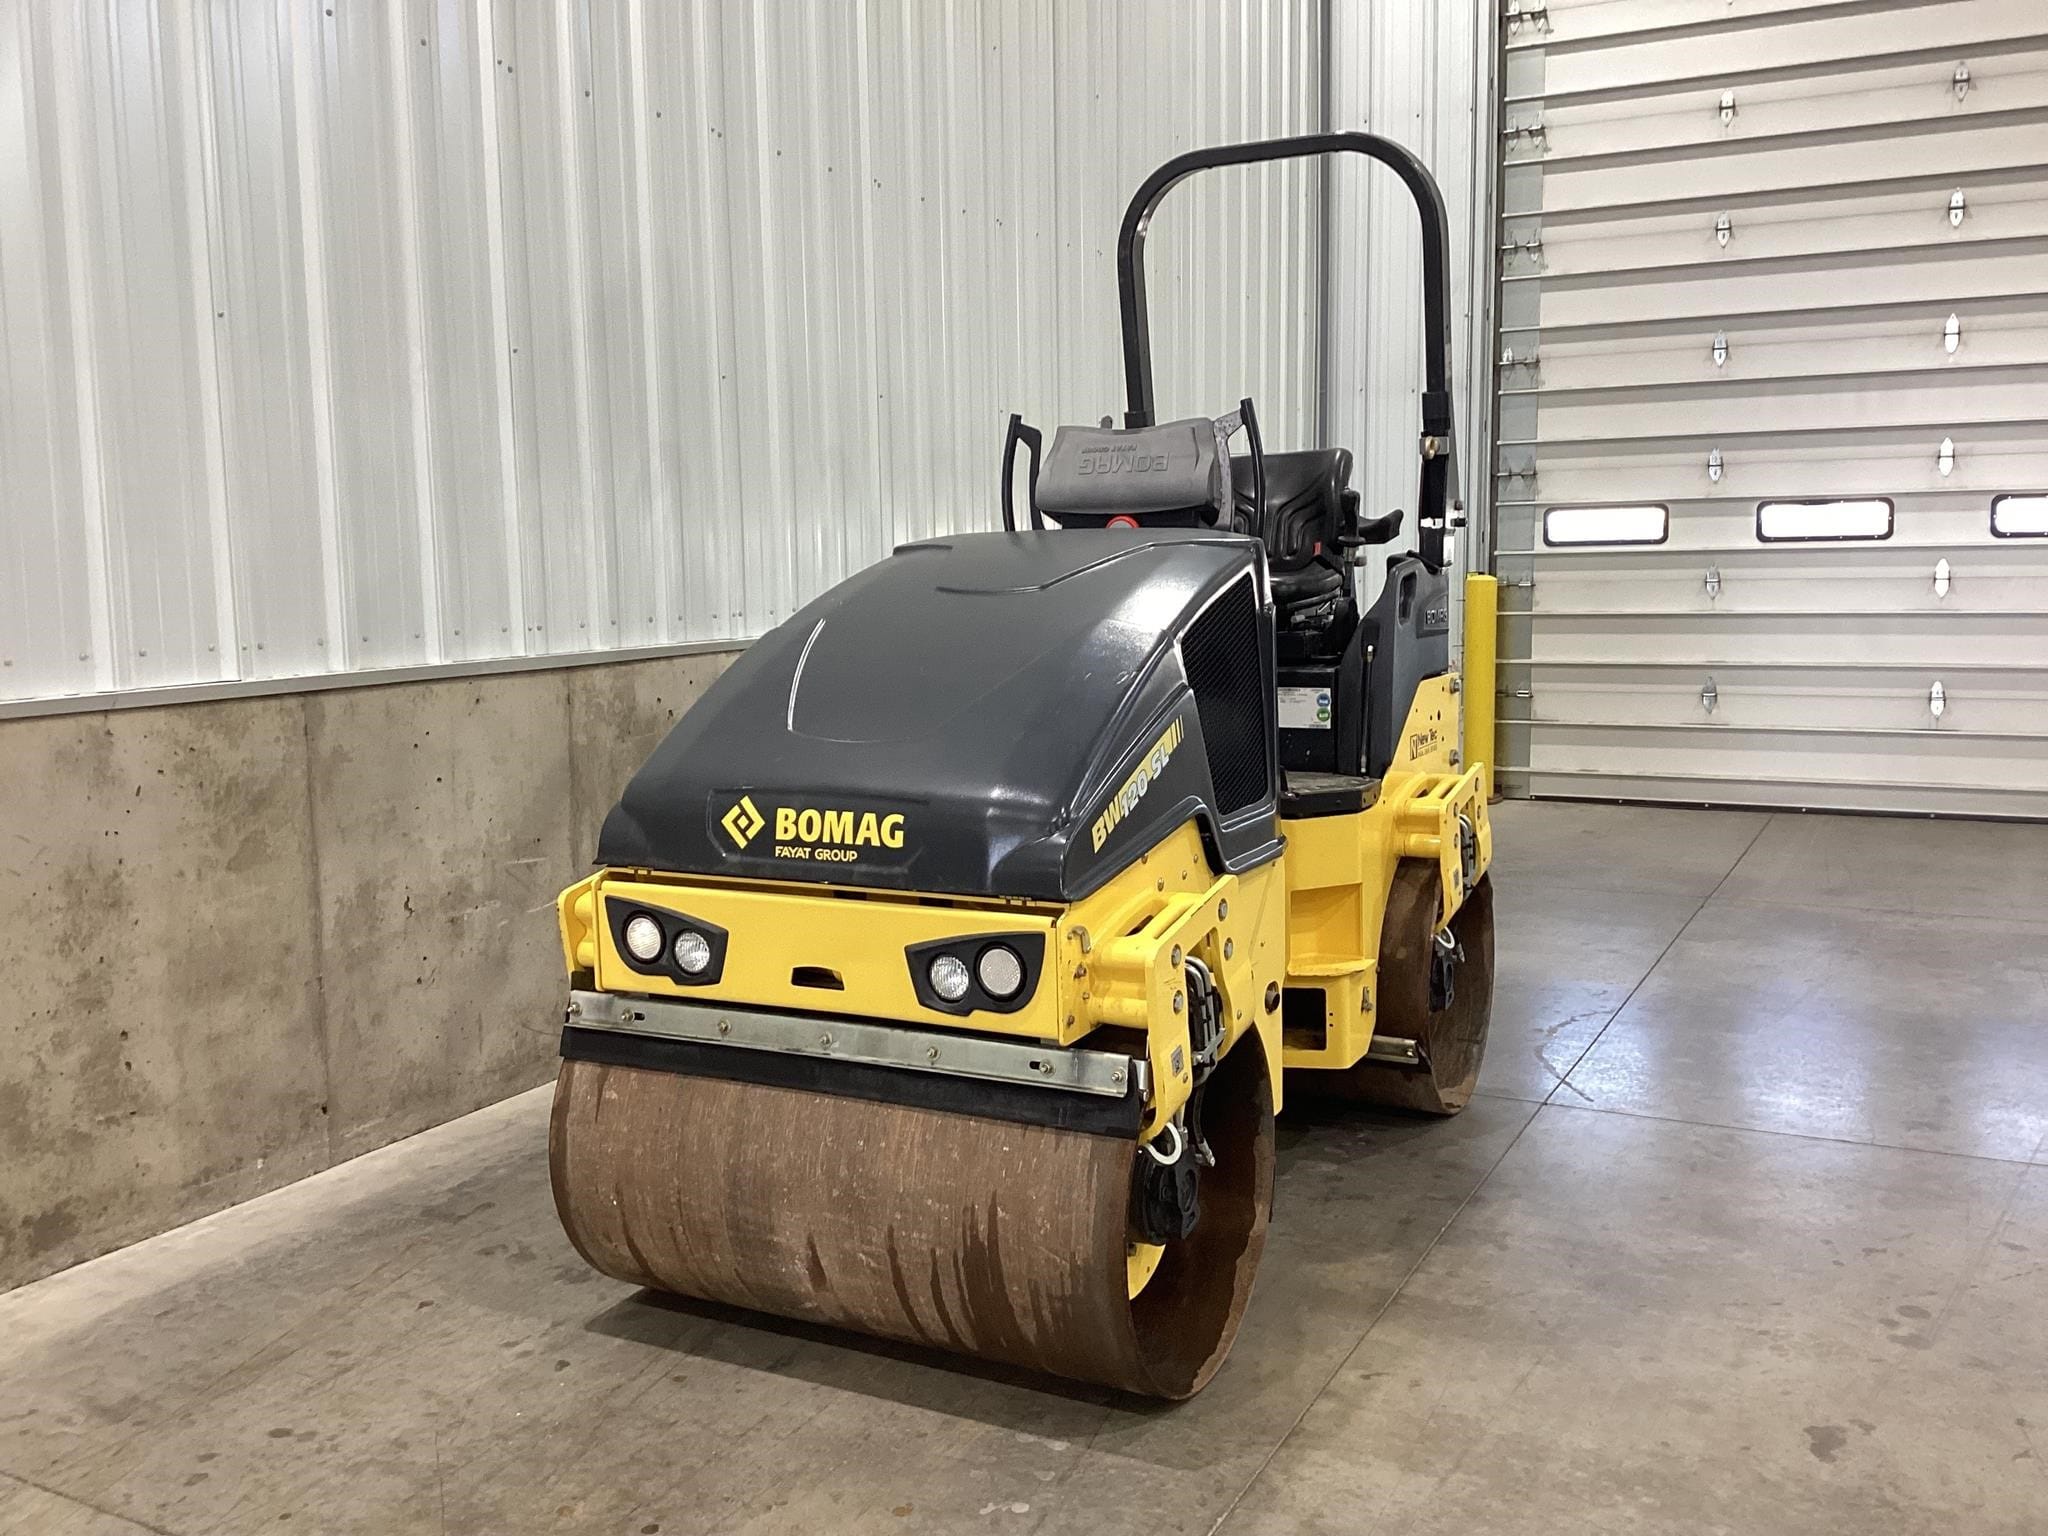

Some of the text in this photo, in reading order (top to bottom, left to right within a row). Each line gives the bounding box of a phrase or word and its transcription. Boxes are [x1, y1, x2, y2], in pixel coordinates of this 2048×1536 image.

[1078, 452, 1170, 476] BOMAG
[775, 807, 905, 848] BOMAG
[775, 845, 858, 862] FAYAT GROUP
